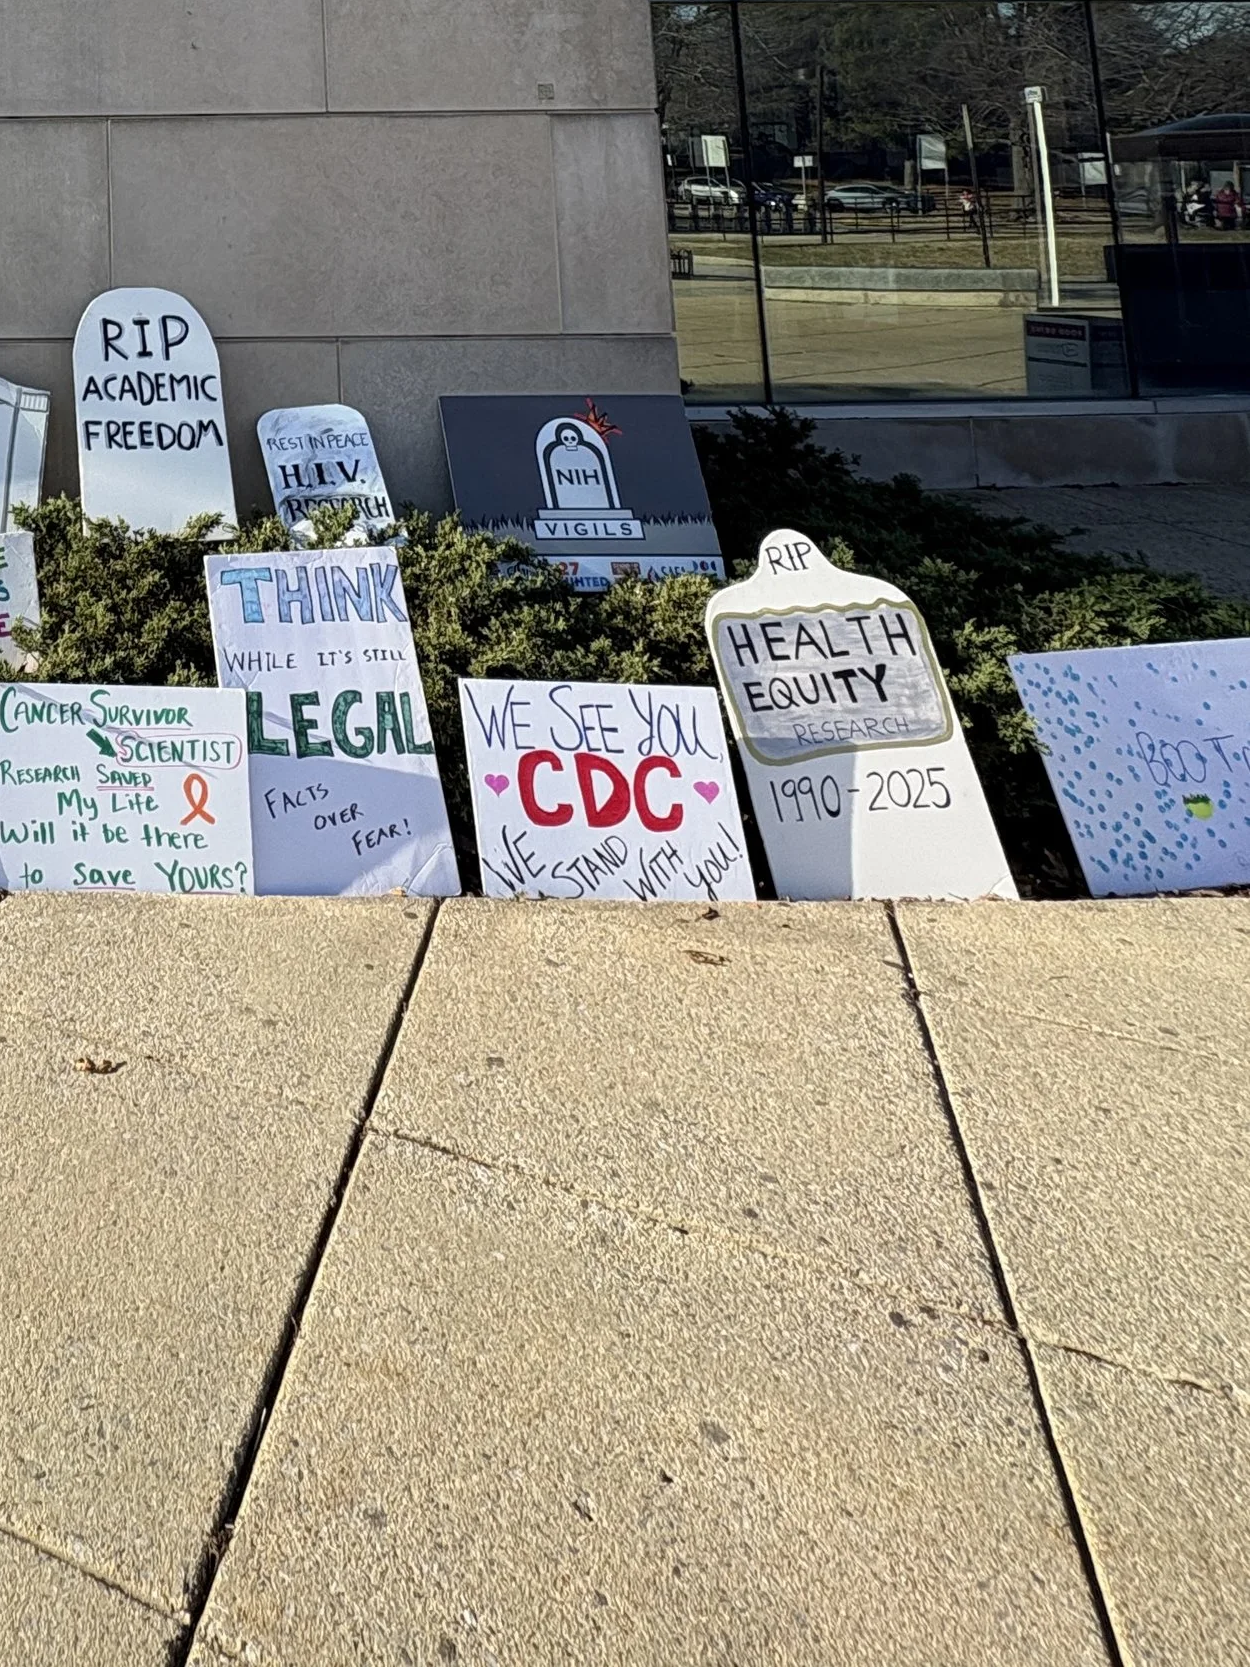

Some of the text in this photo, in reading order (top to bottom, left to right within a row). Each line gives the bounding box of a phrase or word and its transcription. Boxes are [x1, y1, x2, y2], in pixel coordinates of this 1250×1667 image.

[100, 315, 189, 361] RIP
[82, 371, 217, 406] ACADEMIC
[82, 419, 224, 451] FREEDOM
[266, 432, 369, 451] REST IN PEACE
[278, 459, 366, 489] H.I.V.
[555, 469, 600, 485] NIH
[544, 522, 633, 536] VIGILS
[765, 541, 811, 575] RIP
[220, 563, 407, 625] THINK
[727, 613, 917, 667] HEALTH
[224, 648, 406, 673] WHILE IT'S STILL
[743, 664, 890, 712] EQUITY
[246, 690, 435, 759] LEGAL
[464, 684, 535, 750] WE
[549, 685, 624, 753] SEE
[794, 717, 909, 746] RESEARCH
[118, 736, 235, 764] SCIENTIST
[57, 789, 159, 821] My Life
[265, 783, 329, 819] FACTS
[518, 750, 684, 832] CDC
[314, 803, 364, 831] OVER
[0, 820, 208, 849] Will it be there
[351, 818, 411, 856] FEAR!
[20, 863, 43, 888] to
[154, 860, 247, 893] YOURS?
[482, 824, 546, 892] WE
[549, 835, 628, 899] STAND
[623, 840, 684, 901] WITH
